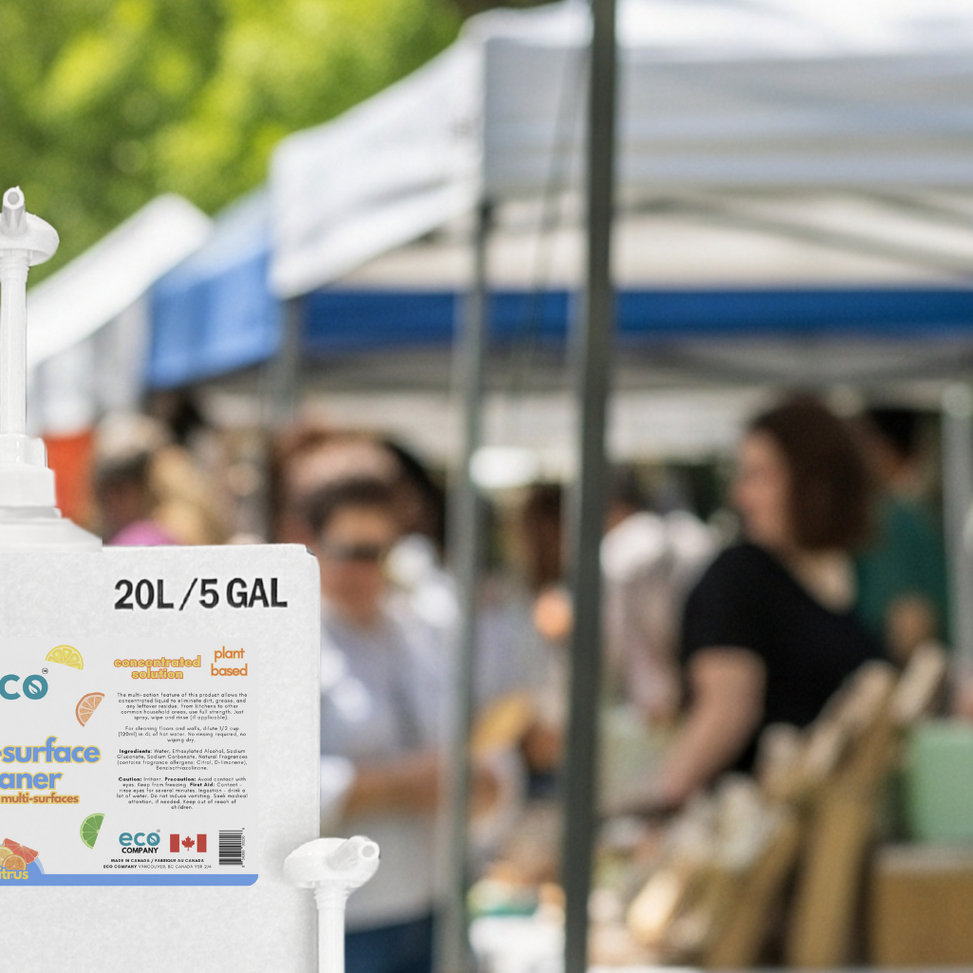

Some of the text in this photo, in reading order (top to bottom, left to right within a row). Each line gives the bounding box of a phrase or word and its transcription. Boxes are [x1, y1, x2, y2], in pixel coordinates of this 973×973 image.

[226, 578, 287, 608] GAL
[214, 645, 245, 663] plant
[113, 655, 201, 668] concentrated
[131, 668, 184, 679] solution
[210, 663, 248, 676] based
[0, 793, 79, 805] multi-surfaces
[118, 832, 161, 847] eco
[121, 846, 158, 855] COMPANY
